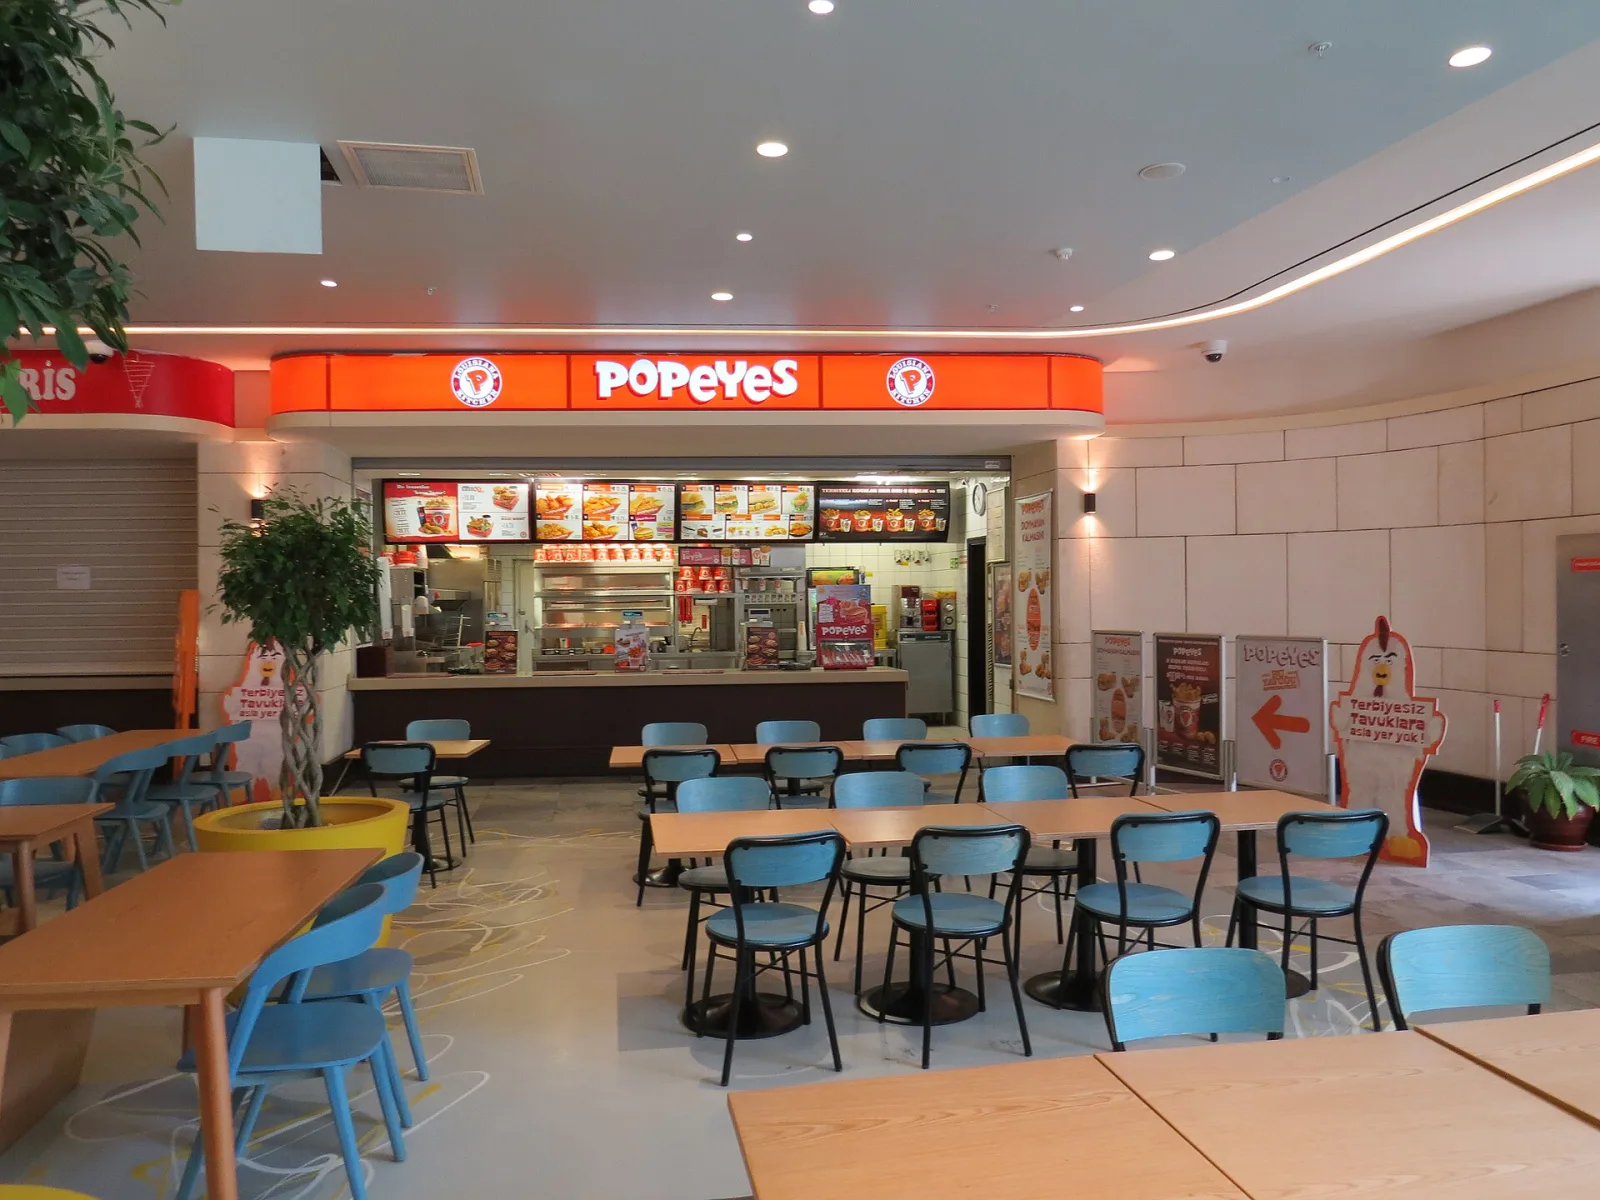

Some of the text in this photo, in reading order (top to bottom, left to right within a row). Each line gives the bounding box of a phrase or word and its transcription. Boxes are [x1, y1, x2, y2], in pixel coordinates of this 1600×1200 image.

[19, 360, 77, 401] RİS
[241, 688, 304, 698] Terbiyez
[1350, 699, 1425, 715] Terbiyesiz
[1350, 713, 1425, 731] Tavuklara
[1350, 727, 1371, 737] asla
[1373, 730, 1393, 741] yer
[1396, 733, 1418, 744] yok
